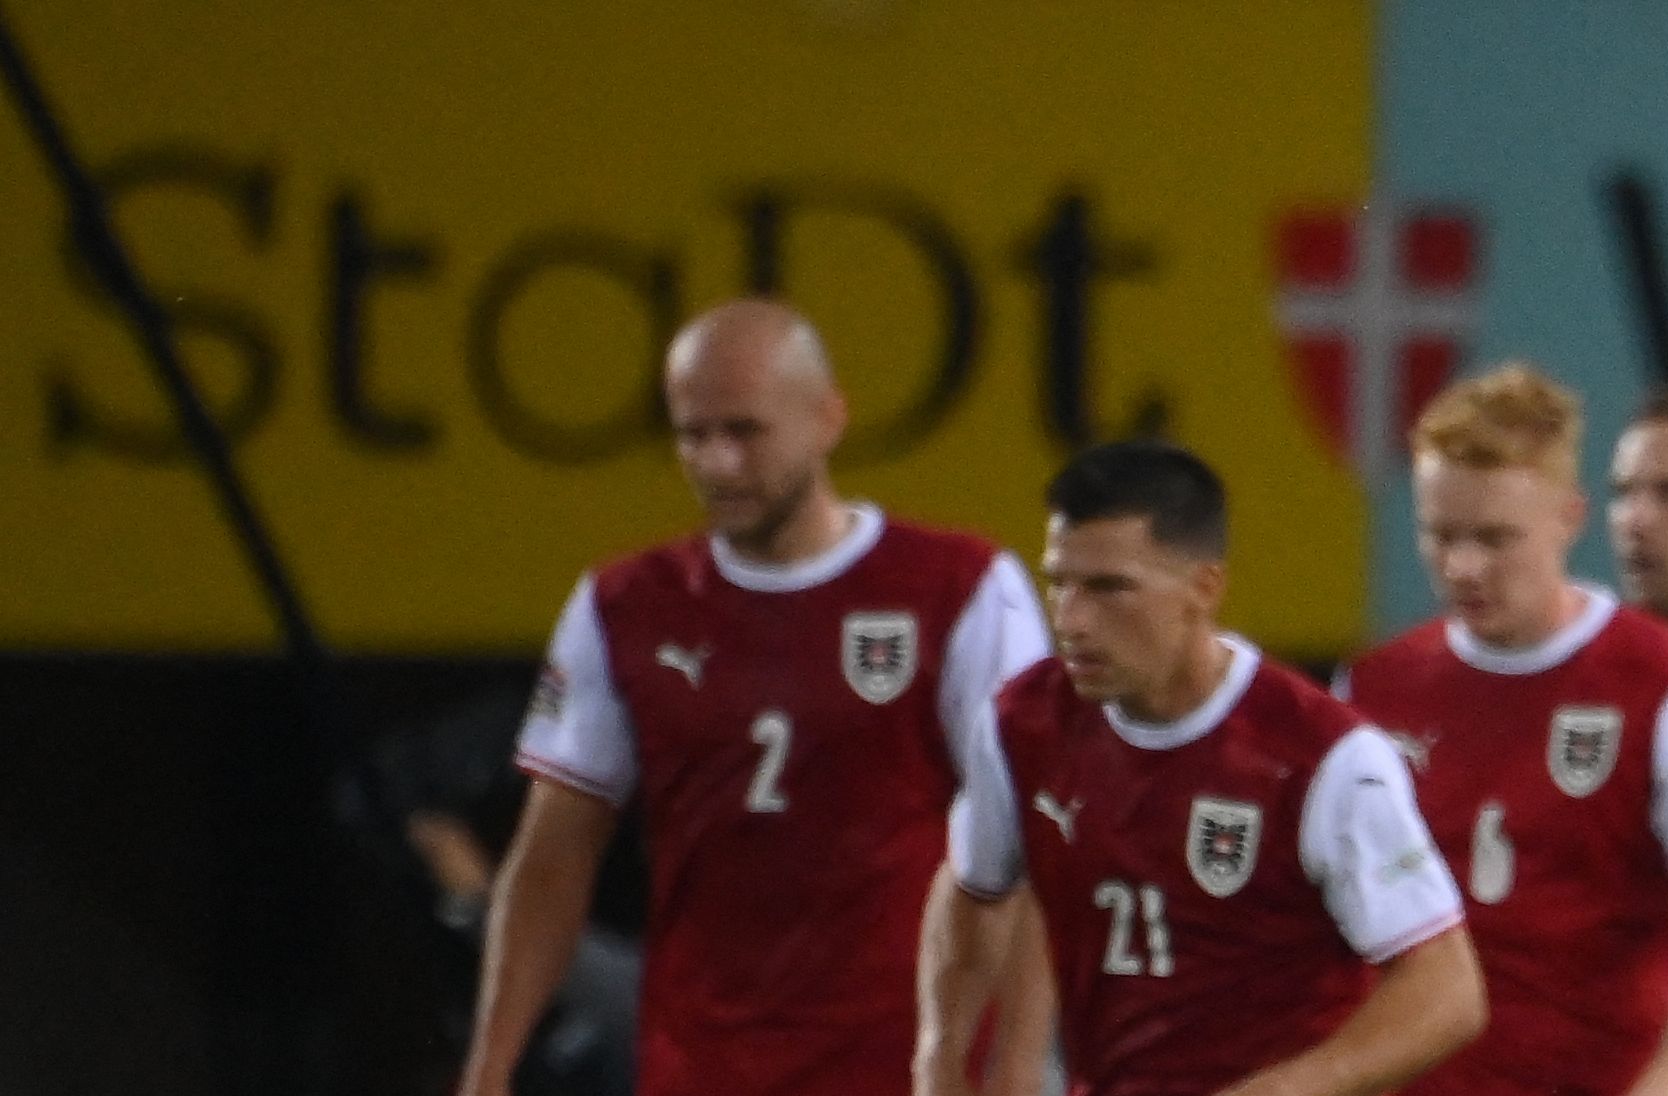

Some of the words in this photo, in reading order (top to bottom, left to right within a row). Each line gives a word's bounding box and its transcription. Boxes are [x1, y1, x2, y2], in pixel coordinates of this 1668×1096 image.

[748, 711, 791, 813] 2
[1470, 802, 1515, 905] 6
[1095, 881, 1174, 977] 21
